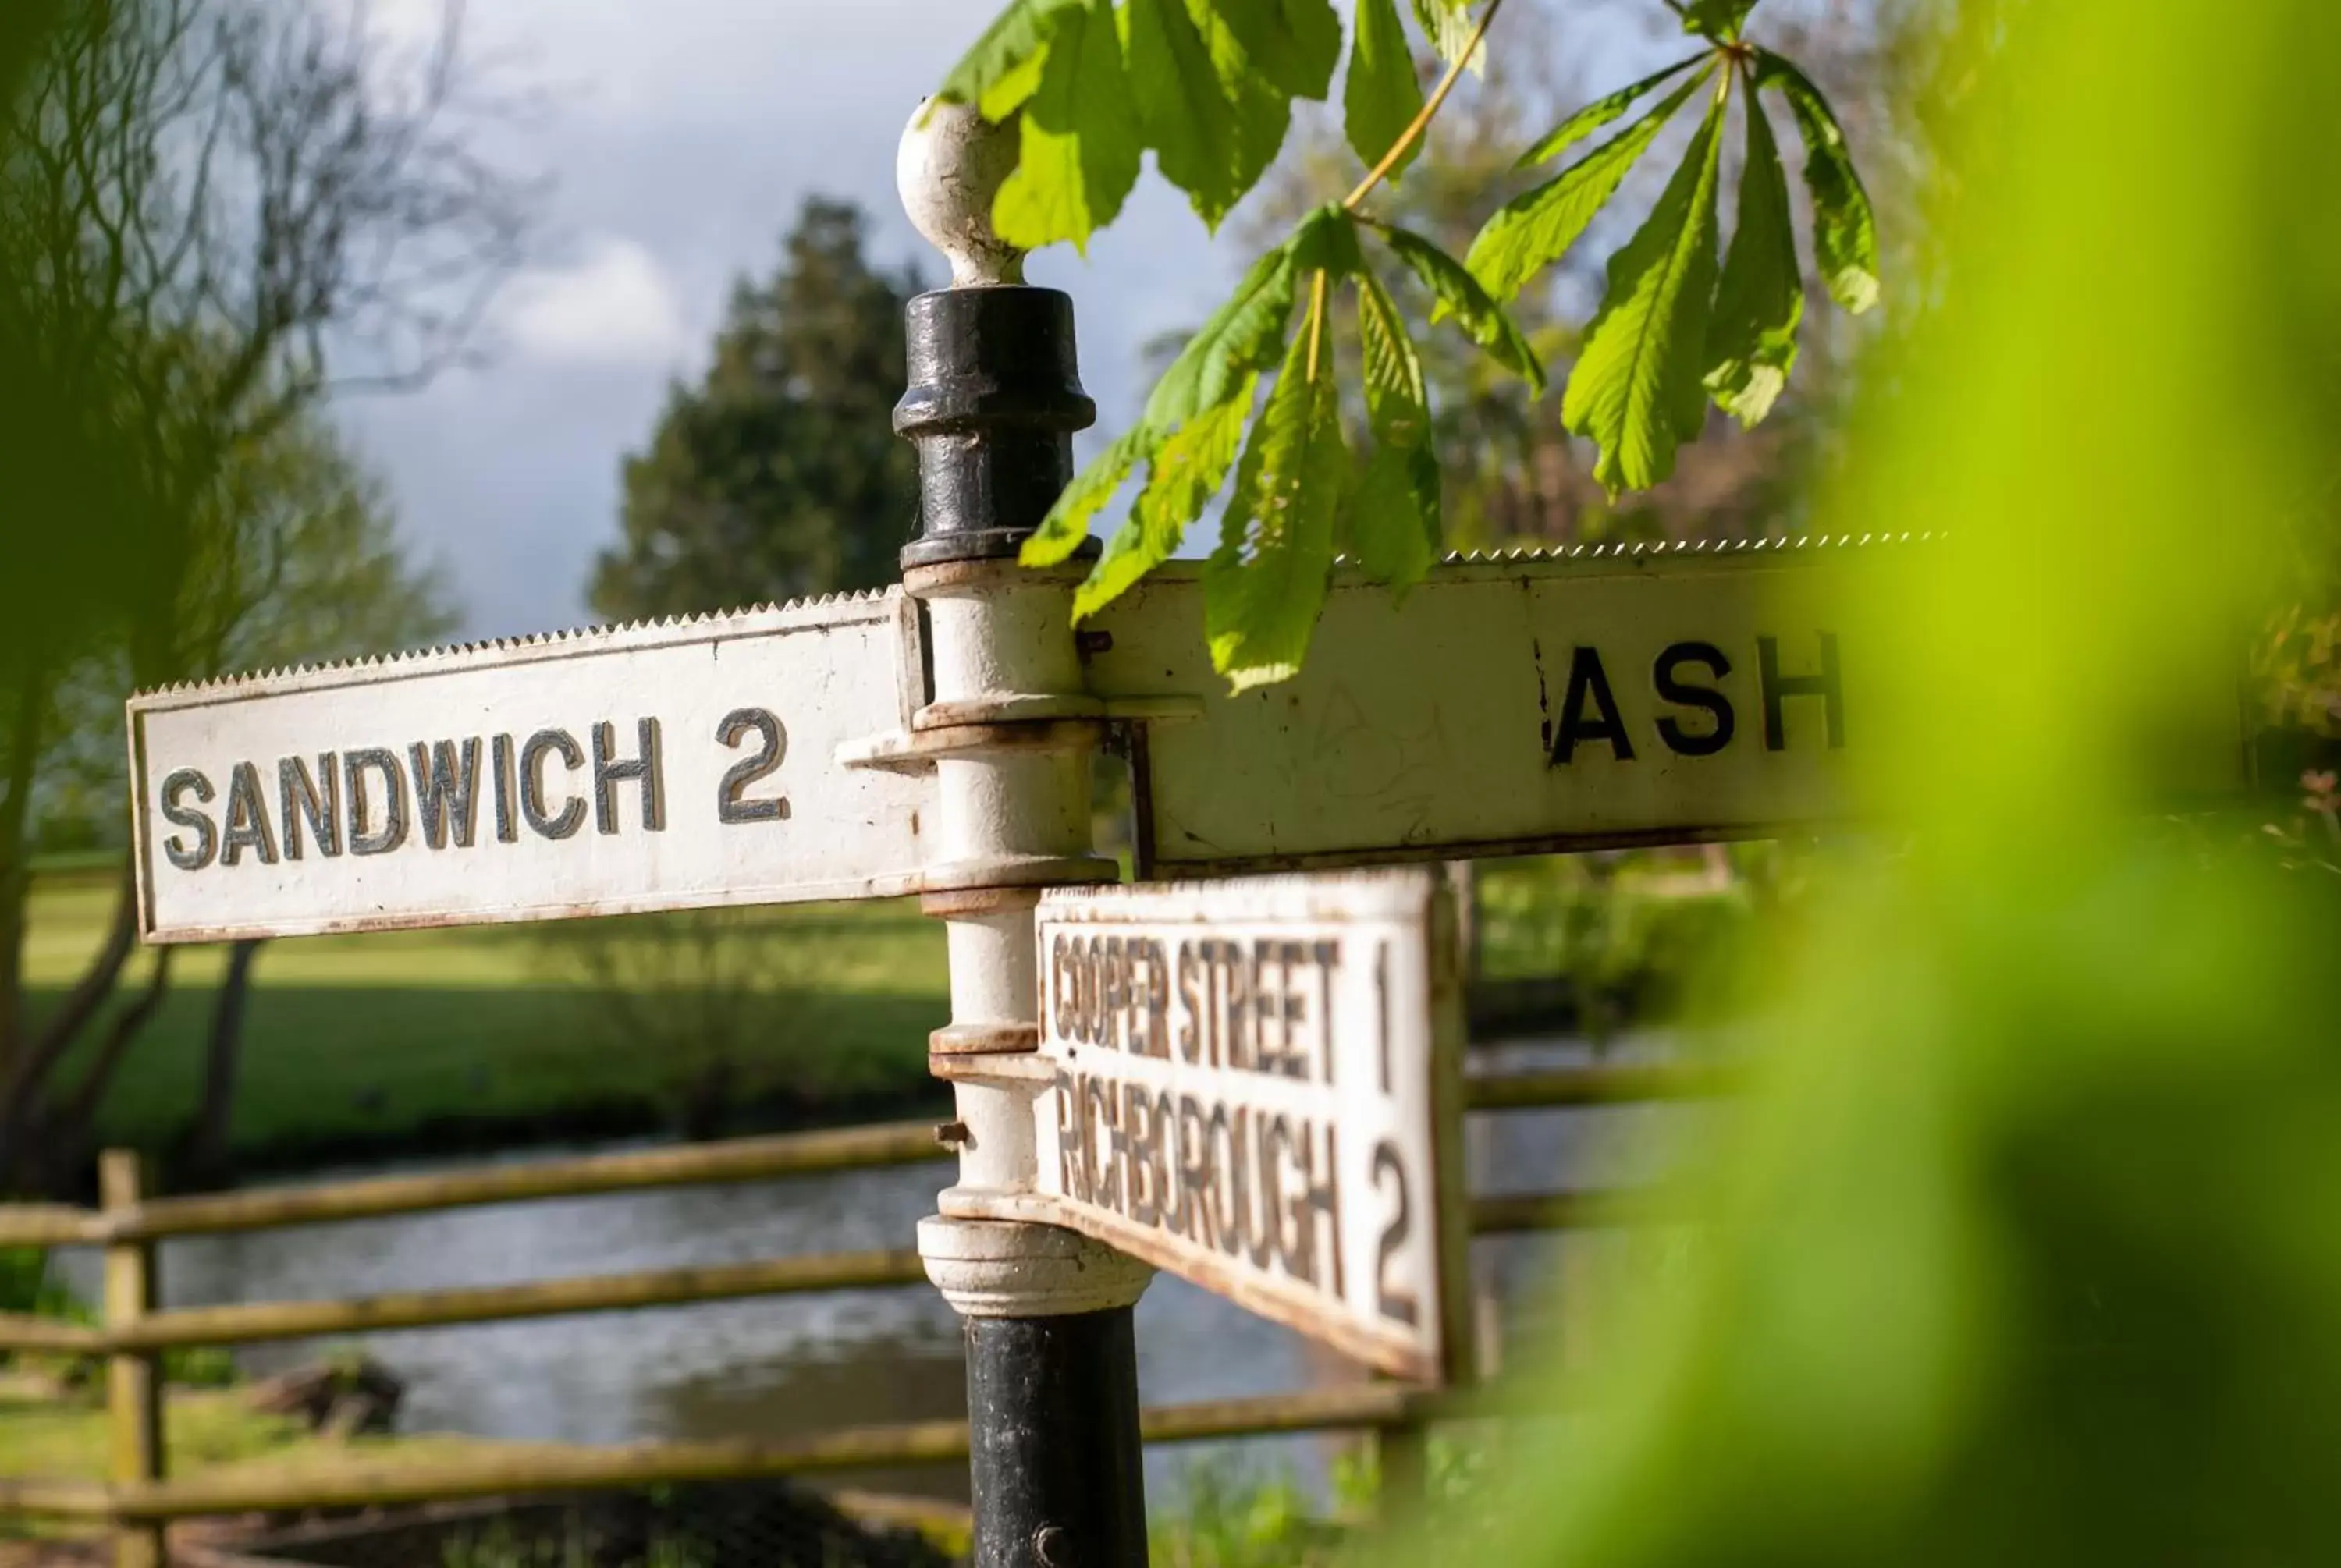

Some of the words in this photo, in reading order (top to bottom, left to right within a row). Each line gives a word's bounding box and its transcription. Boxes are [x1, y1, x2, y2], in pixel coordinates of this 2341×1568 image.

[1548, 632, 1846, 768] ASH
[160, 715, 667, 871] SANDWICH
[714, 705, 790, 825] 2
[1053, 934, 1171, 1059] COOPER
[1176, 936, 1339, 1086] STREET
[1375, 941, 1392, 1094] 1
[1054, 1067, 1347, 1300] RICHBOROUGH
[1368, 1139, 1419, 1326] 2
